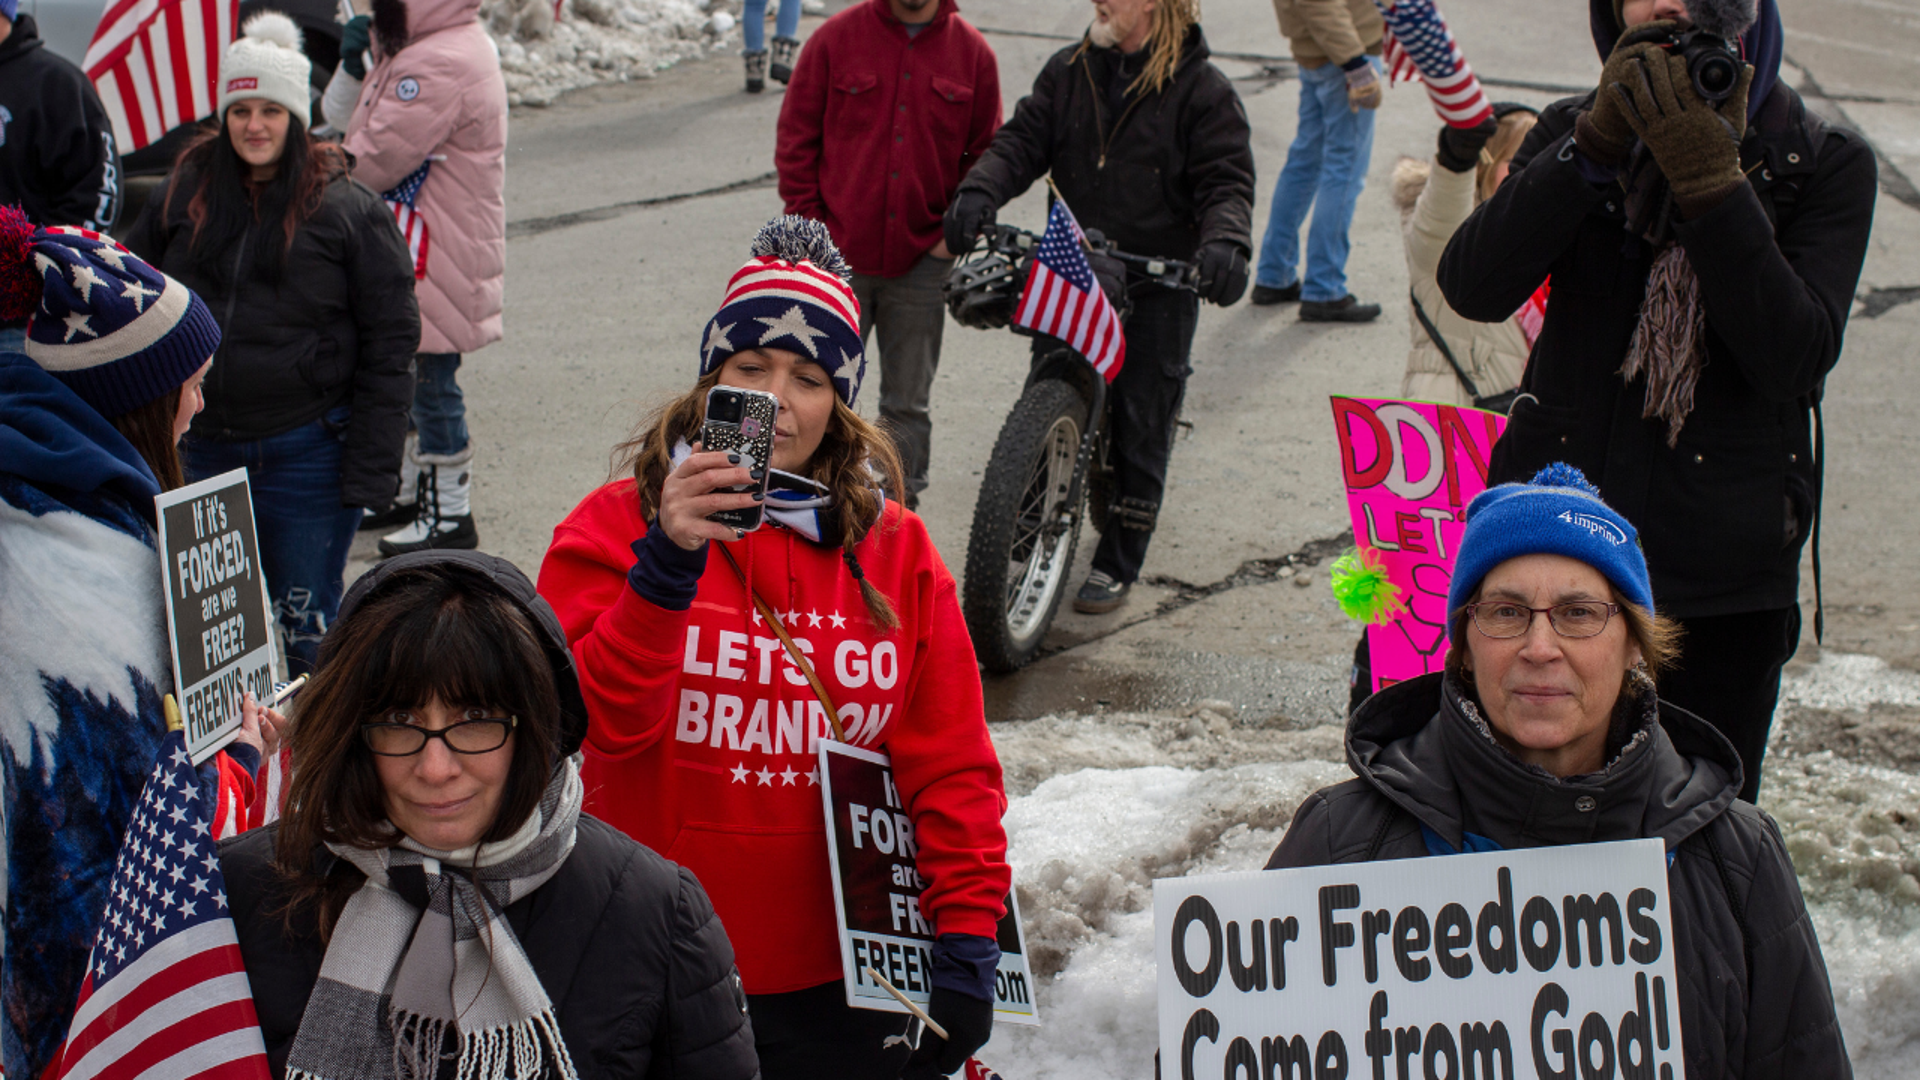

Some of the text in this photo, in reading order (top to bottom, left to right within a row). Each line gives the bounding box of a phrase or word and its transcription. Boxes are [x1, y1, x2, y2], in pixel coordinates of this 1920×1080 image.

[1329, 396, 1500, 508] DON
[191, 494, 228, 540] If it's
[1557, 509, 1619, 547] 4imprint
[176, 529, 252, 600] FORCED,
[201, 585, 238, 622] are we
[202, 612, 246, 671] FREE?
[682, 624, 898, 690] LETS GO
[675, 687, 894, 756] BRANDON
[848, 802, 918, 859] FOR
[891, 863, 928, 891] are
[889, 892, 937, 937] FR
[1171, 866, 1662, 998] Our Freedoms
[1181, 971, 1675, 1080] Come from God!
